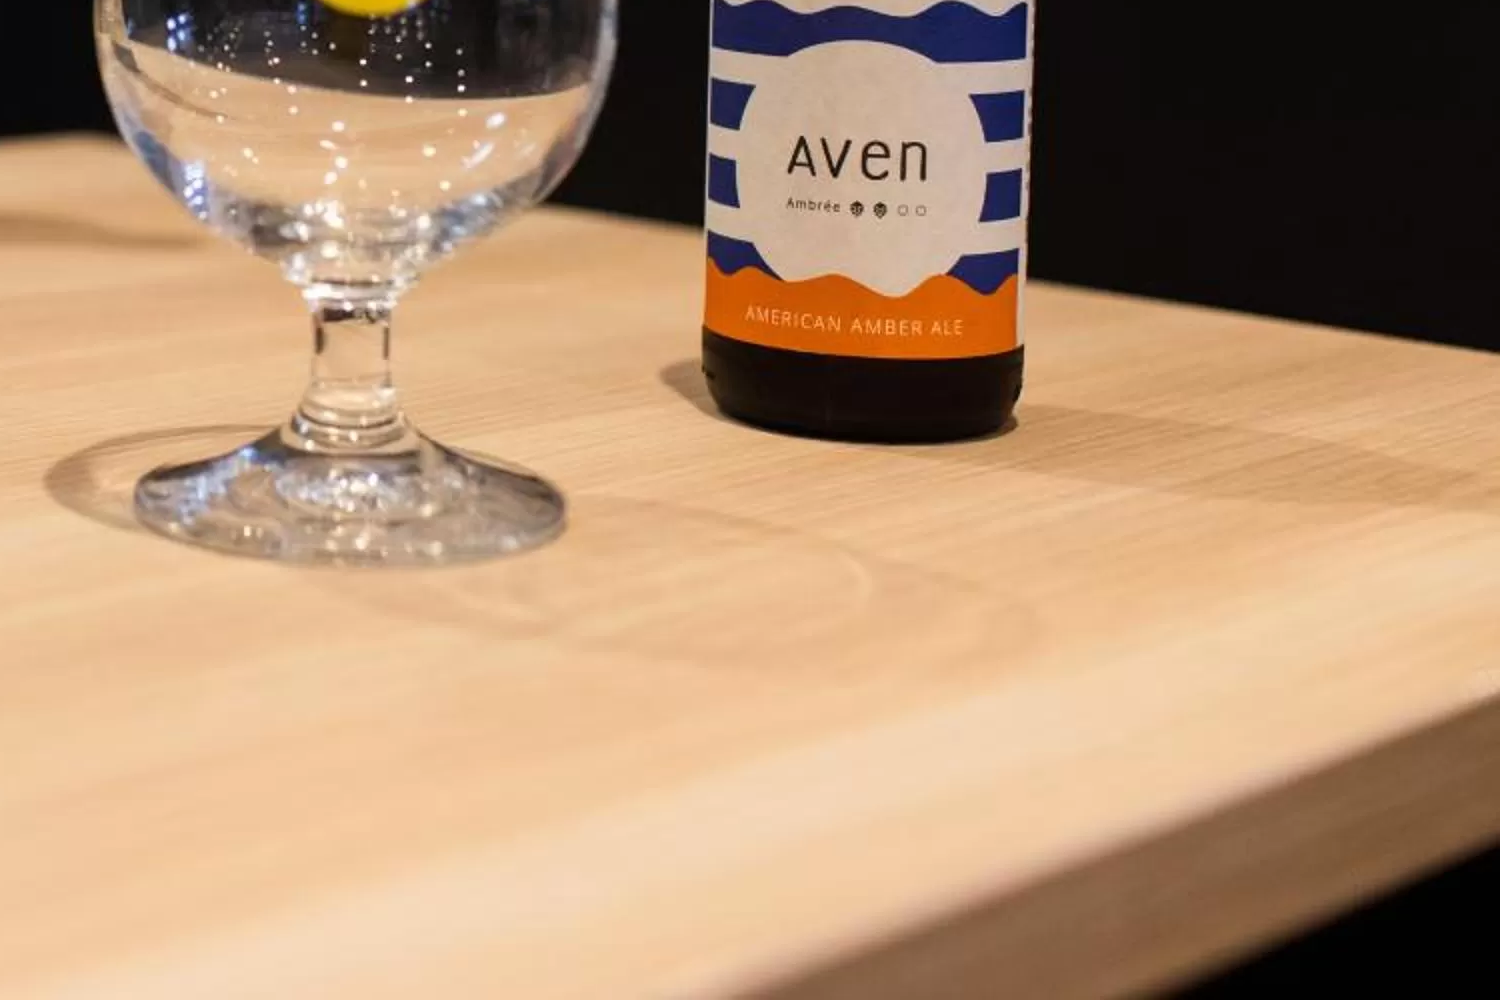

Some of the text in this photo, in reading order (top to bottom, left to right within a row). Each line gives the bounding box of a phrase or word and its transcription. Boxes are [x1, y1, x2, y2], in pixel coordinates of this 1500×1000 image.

[787, 135, 927, 182] Aven
[786, 197, 841, 213] Ambrée
[745, 305, 964, 337] AMERICAN AMBER ALE
